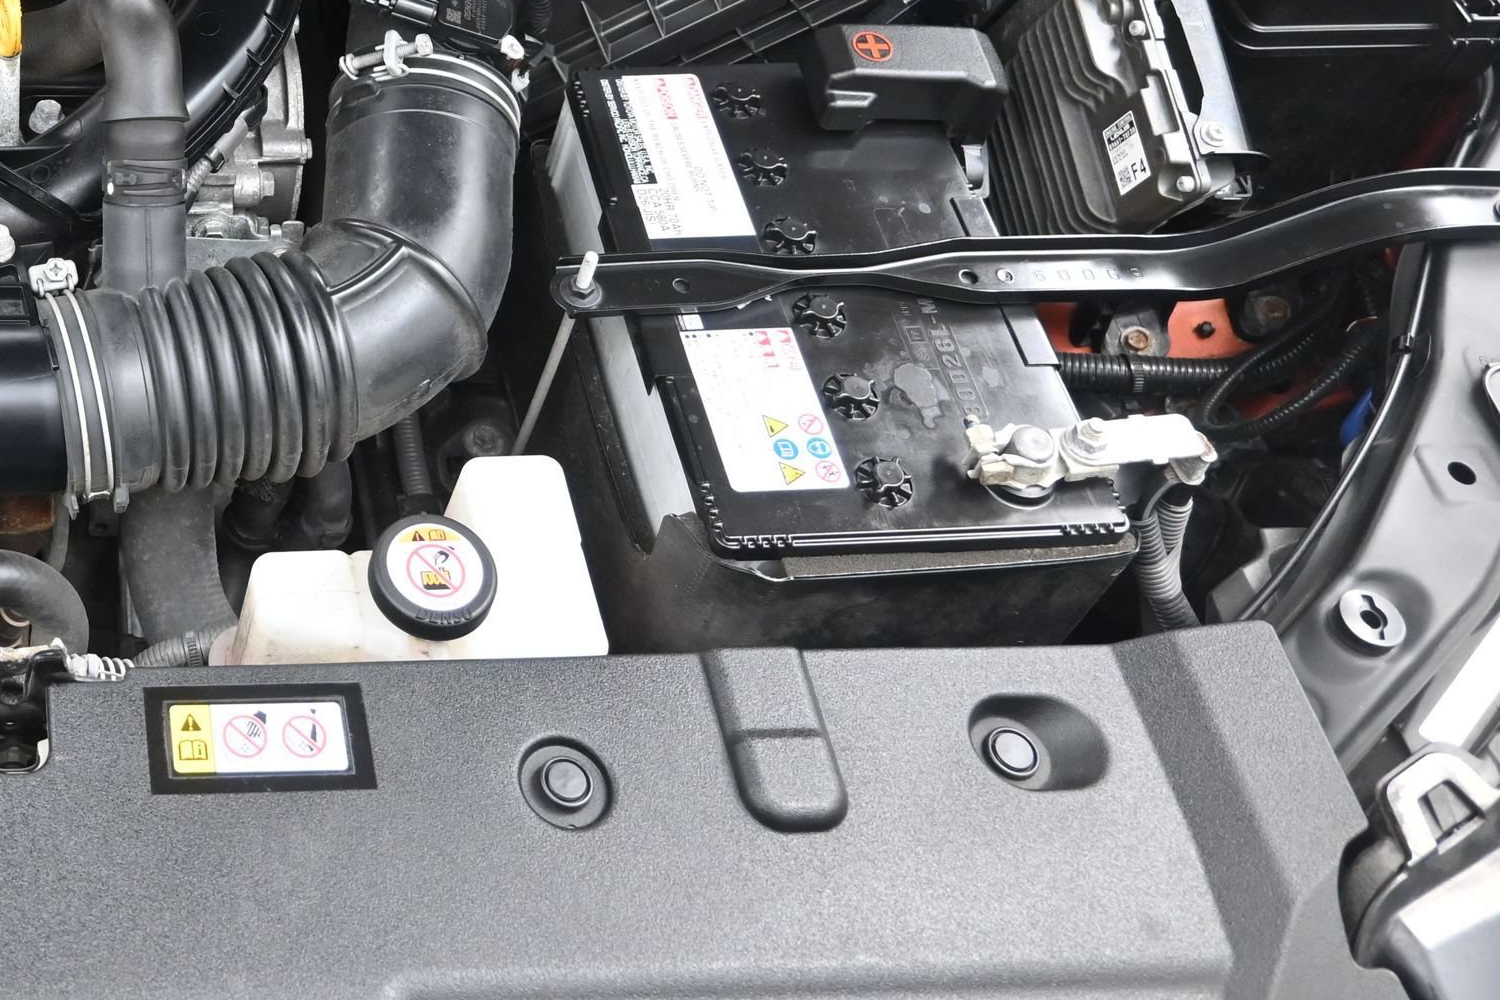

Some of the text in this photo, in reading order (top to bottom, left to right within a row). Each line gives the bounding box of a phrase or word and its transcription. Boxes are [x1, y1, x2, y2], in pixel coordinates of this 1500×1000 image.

[646, 188, 671, 231] CCA 580A
[657, 187, 675, 210] 20HR
[414, 606, 473, 625] DENSO
